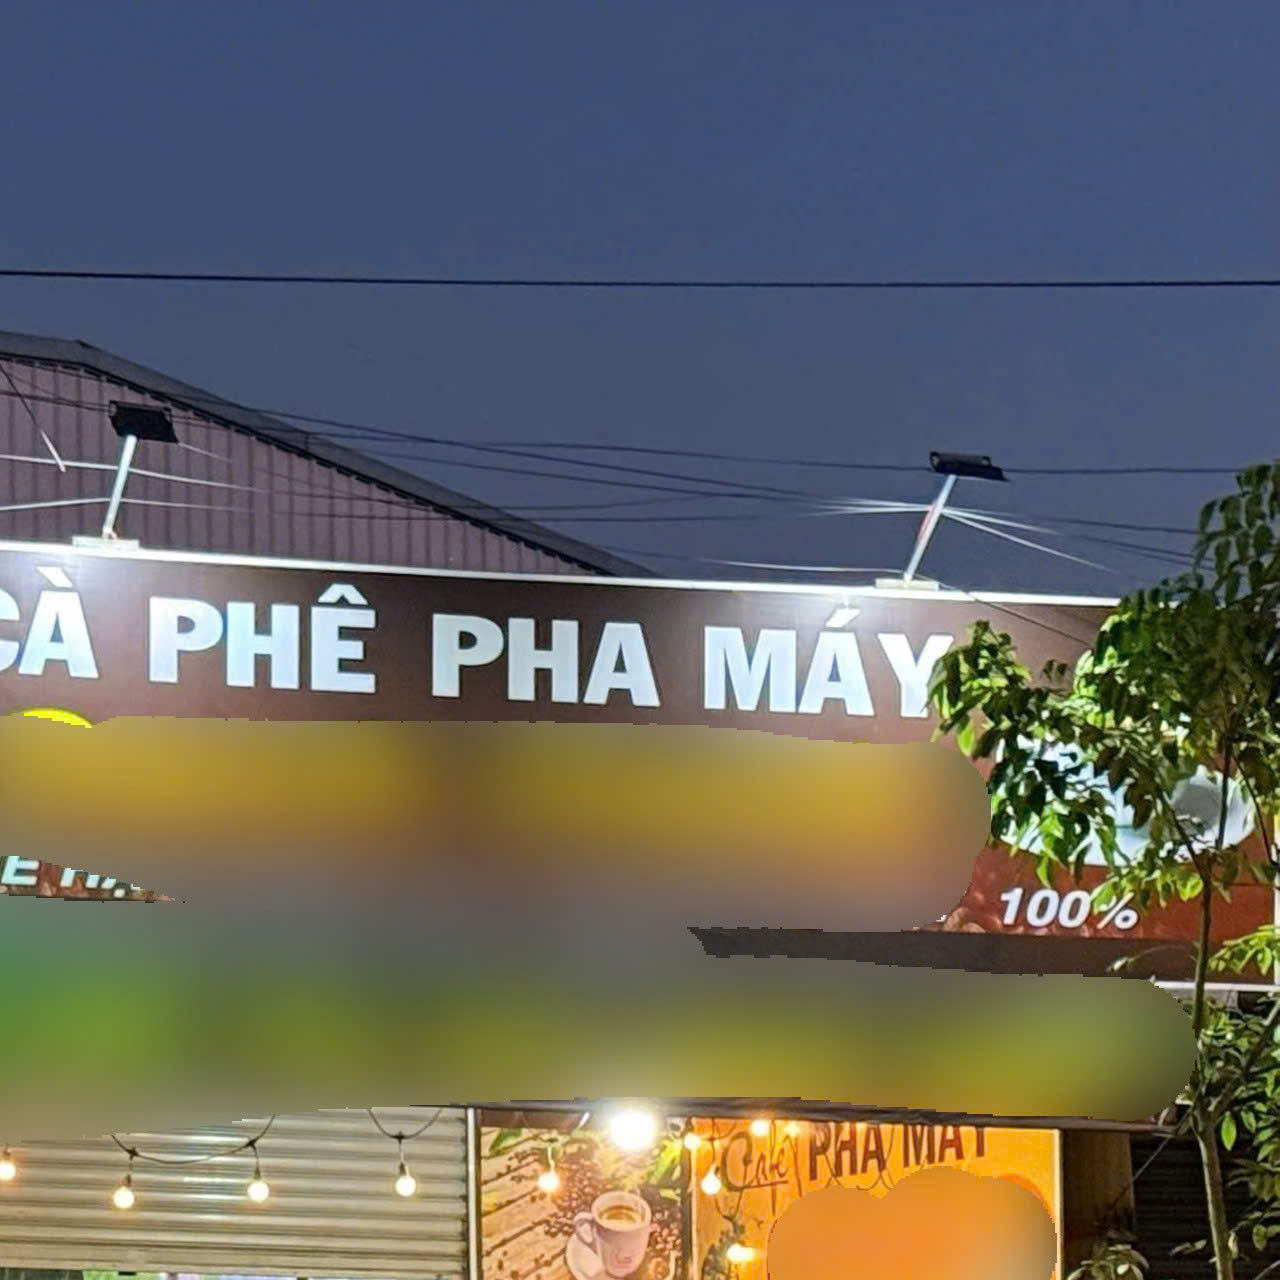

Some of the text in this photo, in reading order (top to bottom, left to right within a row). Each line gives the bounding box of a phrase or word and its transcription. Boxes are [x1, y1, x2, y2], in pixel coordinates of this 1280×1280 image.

[149, 584, 376, 693] PHÊ
[431, 613, 661, 707] PHA
[704, 607, 954, 718] MÁY
[1000, 887, 1138, 930] 100%
